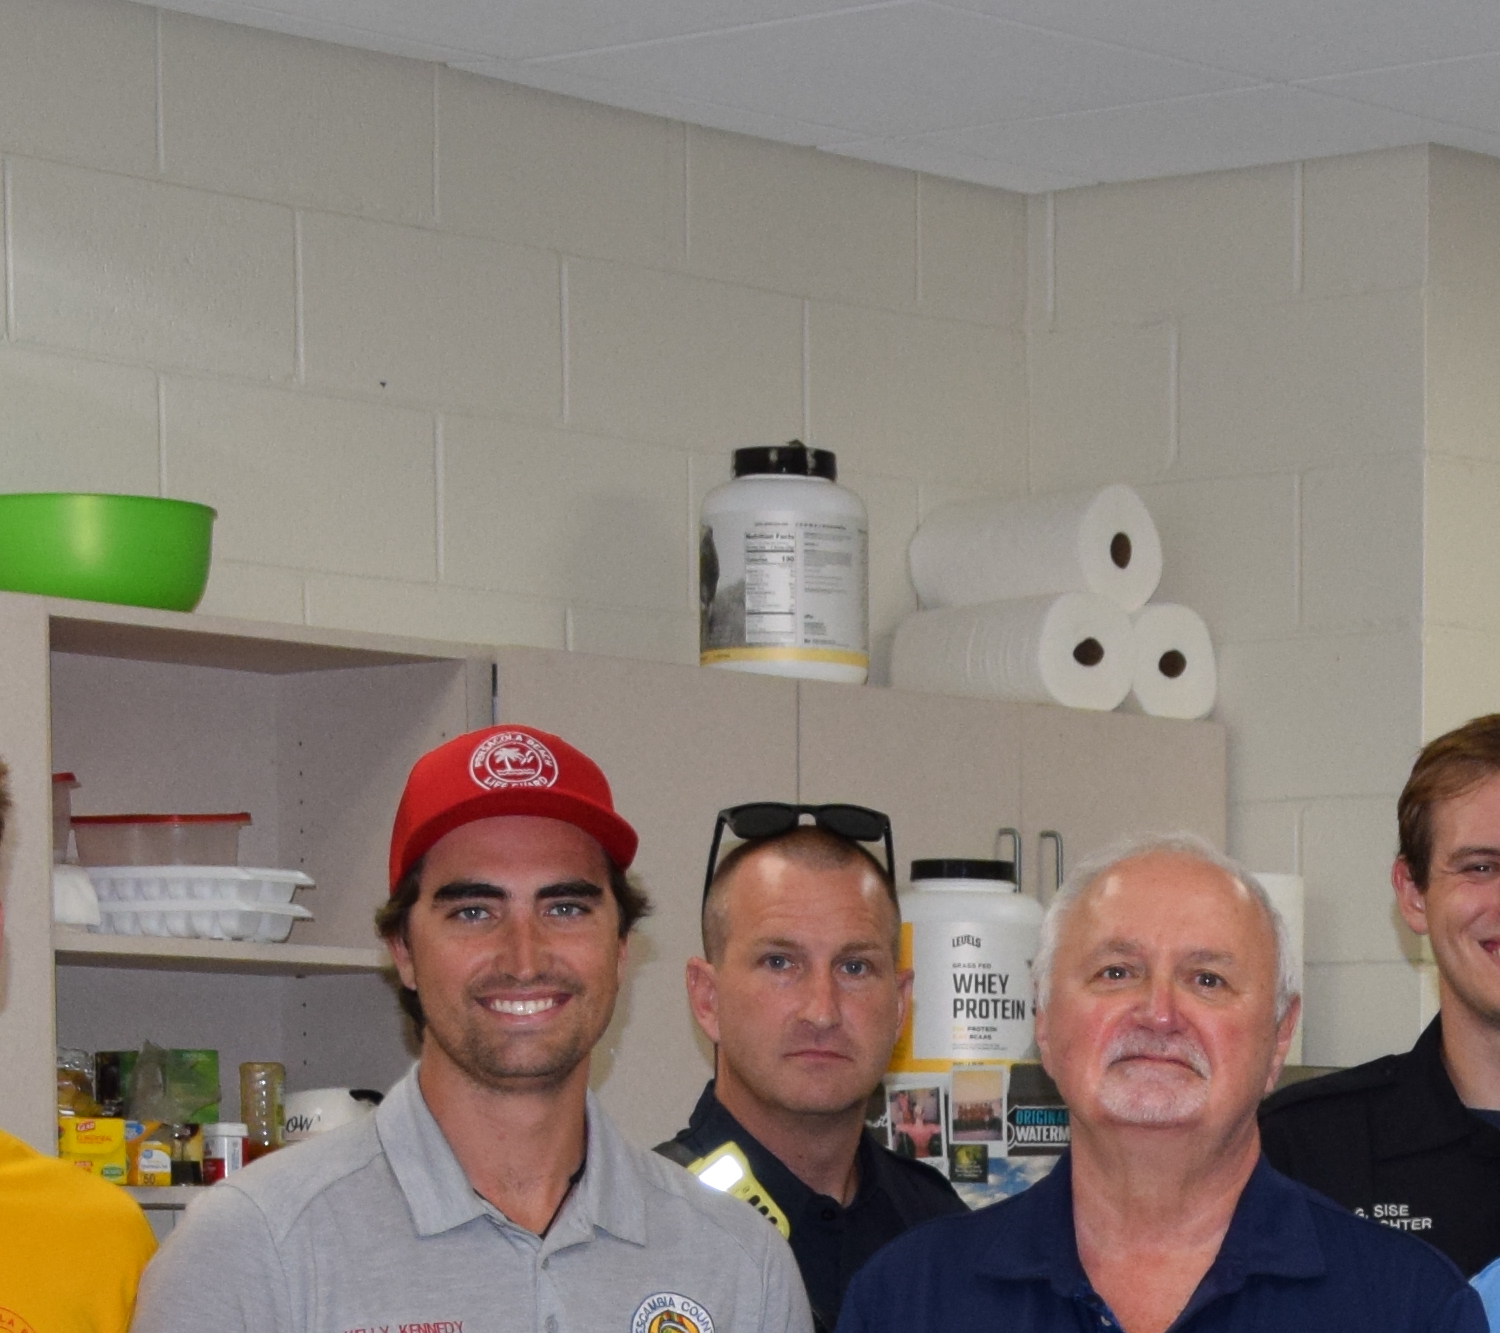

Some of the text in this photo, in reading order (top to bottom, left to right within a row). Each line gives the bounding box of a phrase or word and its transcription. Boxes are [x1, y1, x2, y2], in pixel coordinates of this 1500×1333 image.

[474, 734, 553, 768] PENSACOLA BEACH
[483, 776, 508, 788] LIFE
[952, 934, 982, 949] LEVELS
[953, 973, 1009, 994] WHEY
[953, 998, 1026, 1020] PROTEIN
[1016, 1125, 1070, 1142] WATERM
[1374, 1204, 1409, 1217] SISE
